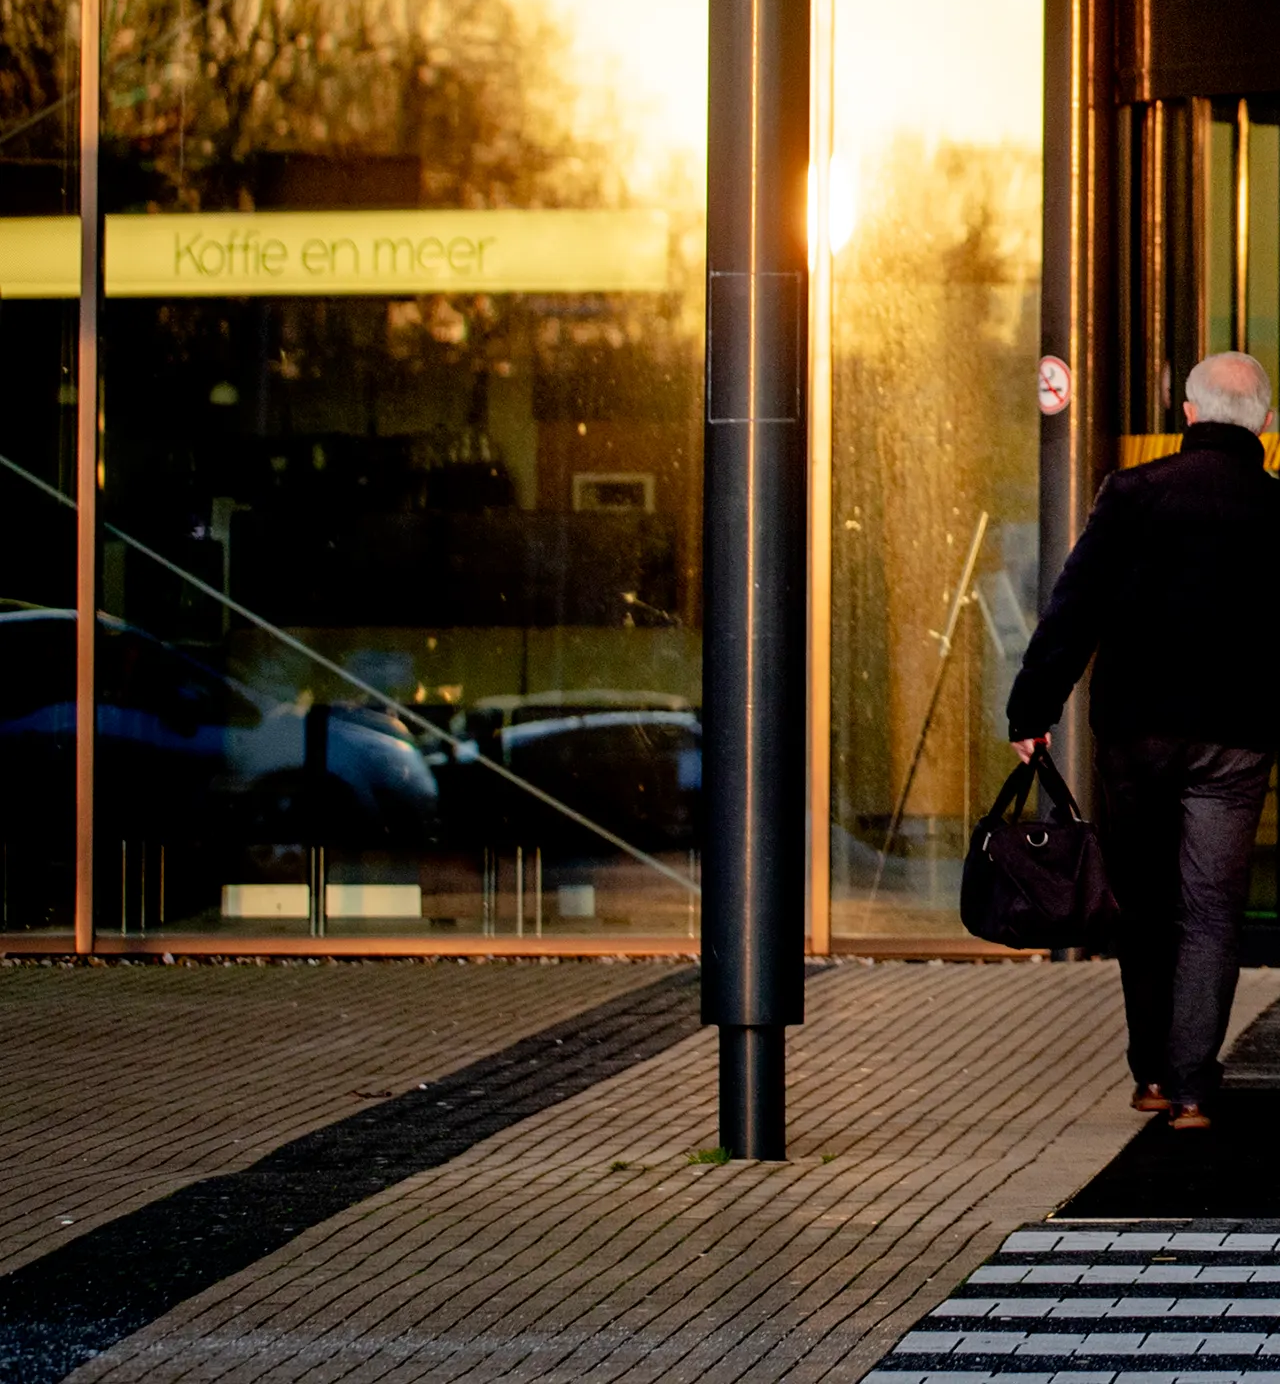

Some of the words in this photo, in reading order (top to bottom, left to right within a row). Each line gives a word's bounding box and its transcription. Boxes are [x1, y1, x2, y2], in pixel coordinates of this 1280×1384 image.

[173, 228, 288, 277] Koffie
[301, 237, 360, 276] en
[373, 235, 496, 276] meer
